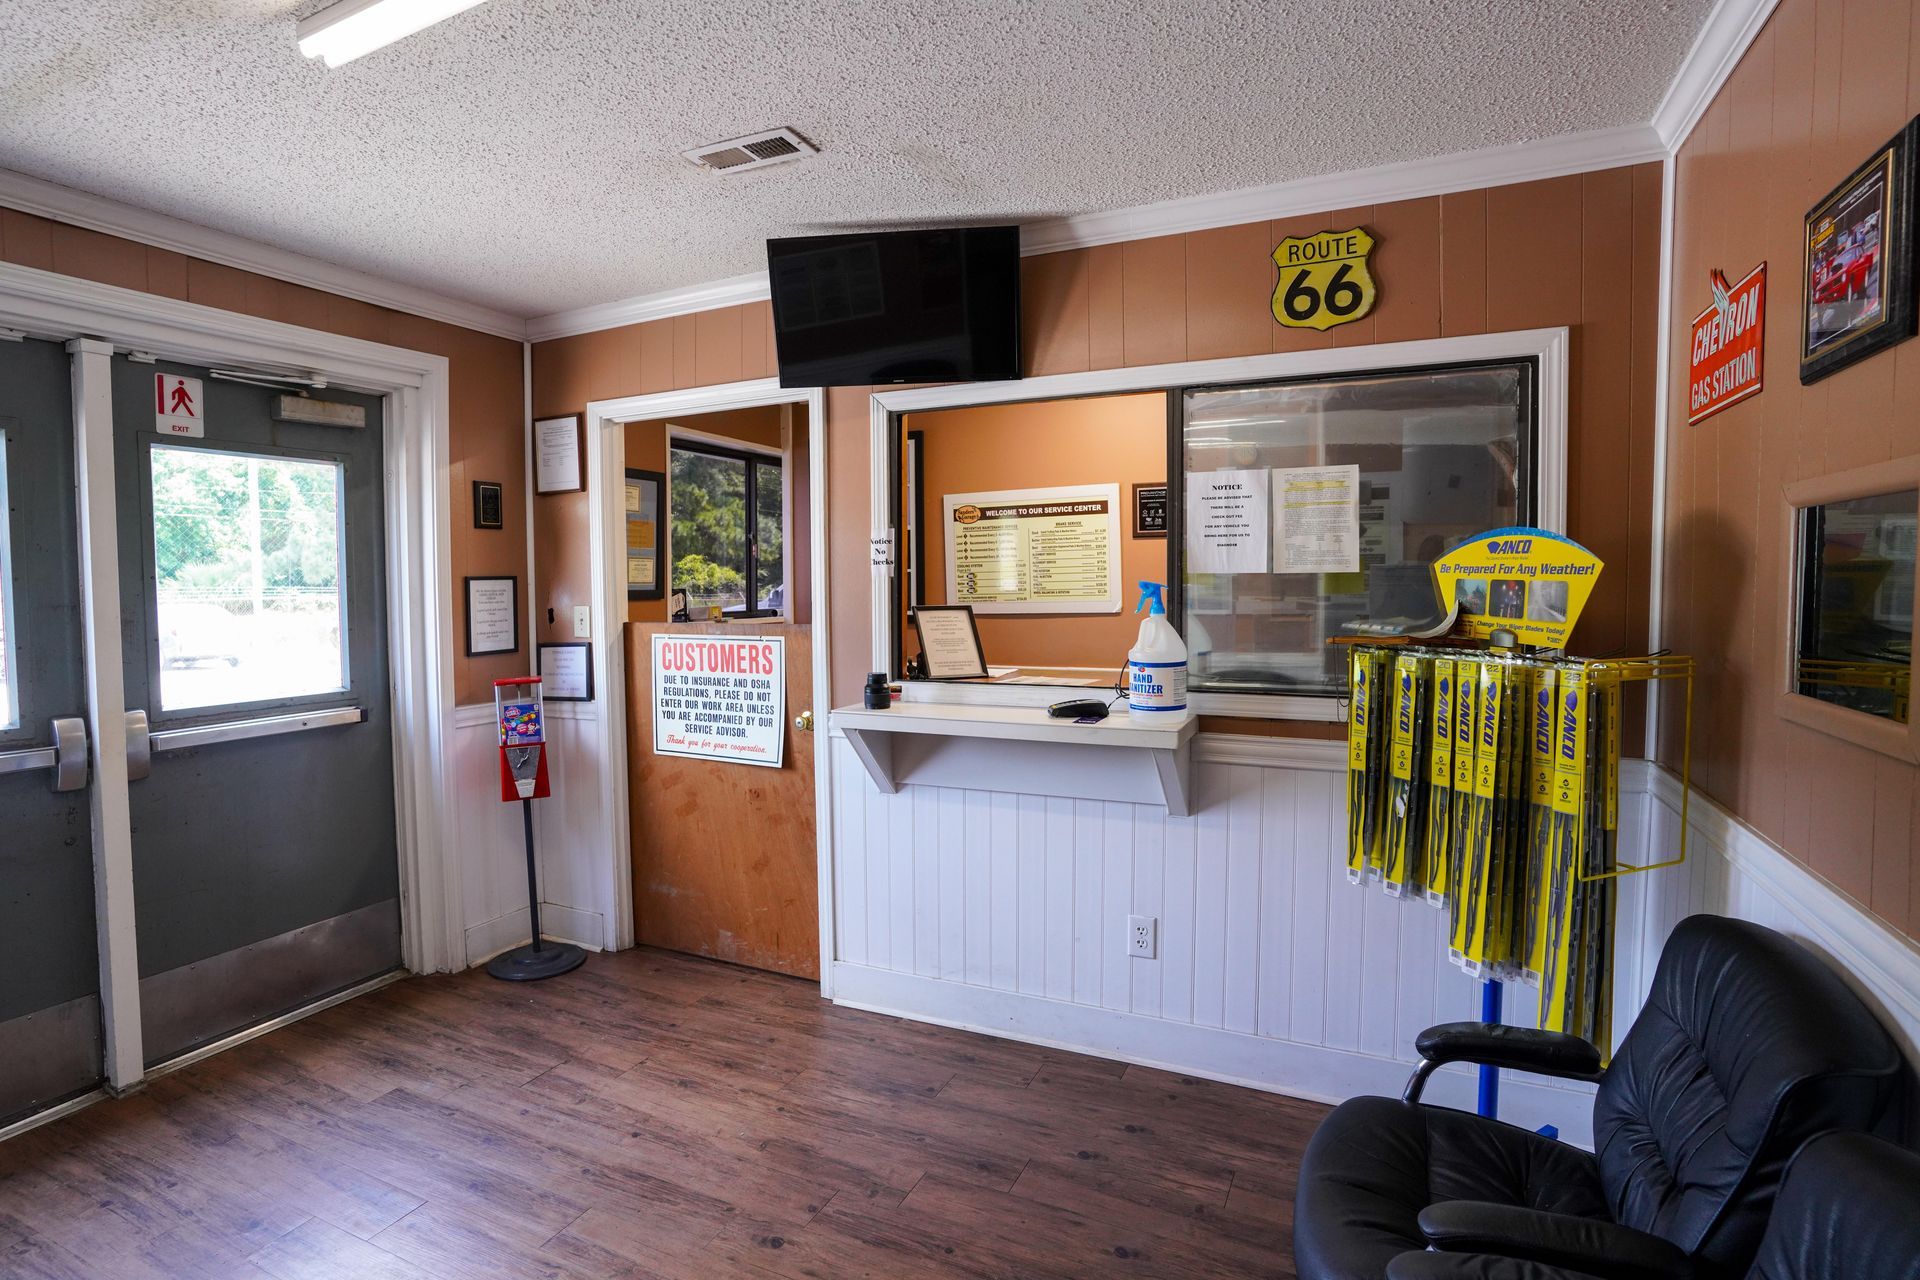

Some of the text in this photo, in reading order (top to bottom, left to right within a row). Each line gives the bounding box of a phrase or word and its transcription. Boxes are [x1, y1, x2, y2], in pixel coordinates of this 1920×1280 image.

[1288, 236, 1357, 262] ROUTE
[1284, 263, 1363, 321] 66
[1692, 282, 1761, 367] CHEVRON
[1691, 347, 1757, 411] GAS STATION
[172, 425, 190, 433] EXIT
[986, 508, 1017, 517] WELCOME
[1029, 507, 1043, 515] OUR
[1044, 505, 1073, 514] SERVICE
[1075, 504, 1102, 512] CENTER
[1497, 539, 1533, 555] ANCO
[1440, 563, 1596, 577] Be Prepared For Any Weather!
[1477, 620, 1495, 629] Change
[1496, 622, 1508, 630] Your
[1508, 623, 1524, 632] Wiper
[1525, 624, 1544, 633] Blades
[1546, 626, 1566, 635] Today!
[662, 642, 773, 675] CUSTOMERS
[1438, 661, 1451, 670] 20
[1461, 663, 1472, 671] 21
[1487, 664, 1500, 673] 22
[664, 675, 771, 690] DUE TO INSURANCE AND OSHA
[1133, 673, 1153, 684] HAND
[663, 687, 771, 702] REGULATIONS, PLEASE DO NOT
[661, 698, 775, 715] ENTER OUR WORK AREA UNLESS
[1355, 682, 1366, 726] ANCO
[1400, 687, 1412, 734] ANCO
[662, 710, 773, 727] YOU ARE ACCOMPANIED BY OUR
[1437, 691, 1449, 739] ANCO
[1460, 695, 1471, 743] ANCO
[1483, 697, 1496, 747] ANCO
[684, 724, 749, 738] SERVICE ADVISOR.
[1536, 703, 1549, 755] ANCO
[1562, 706, 1578, 761] ANCO
[666, 734, 767, 754] Thank you for your cooperation.
